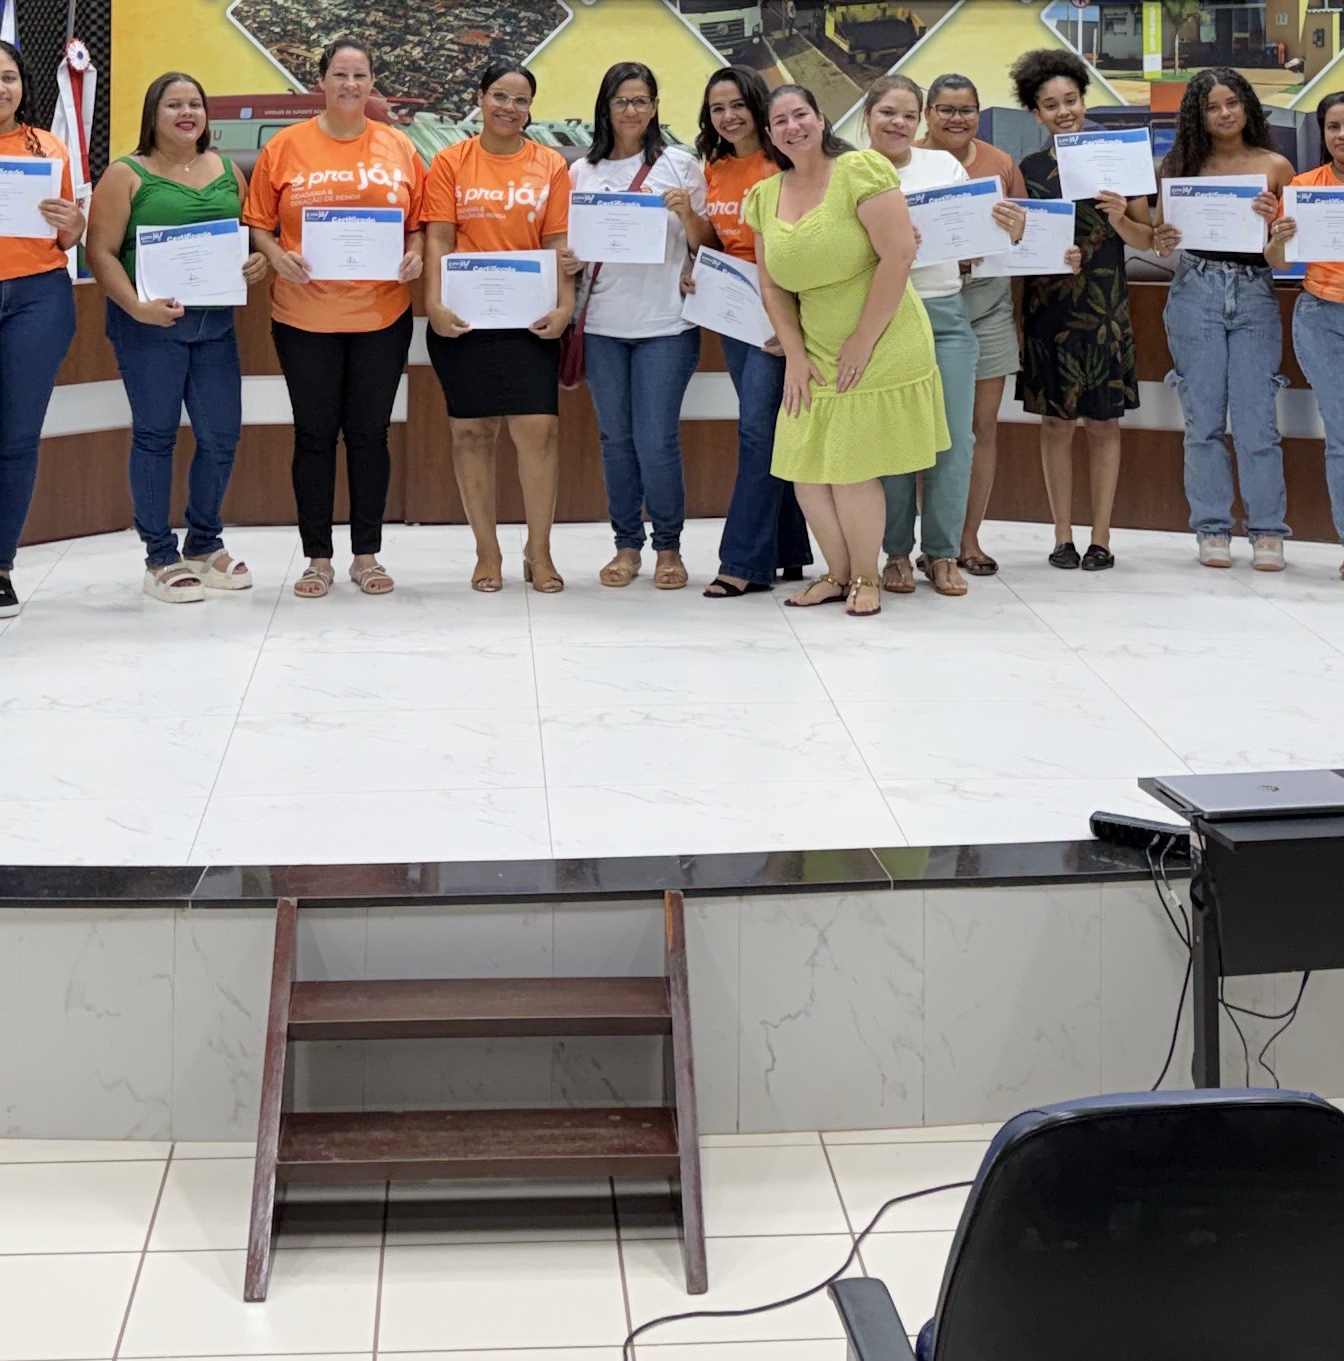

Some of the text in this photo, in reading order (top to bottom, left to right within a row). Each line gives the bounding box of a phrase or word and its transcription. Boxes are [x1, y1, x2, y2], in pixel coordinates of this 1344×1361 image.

[307, 169, 355, 190] pra
[356, 161, 402, 204] já!
[463, 186, 505, 206] pra
[504, 180, 550, 224] já!
